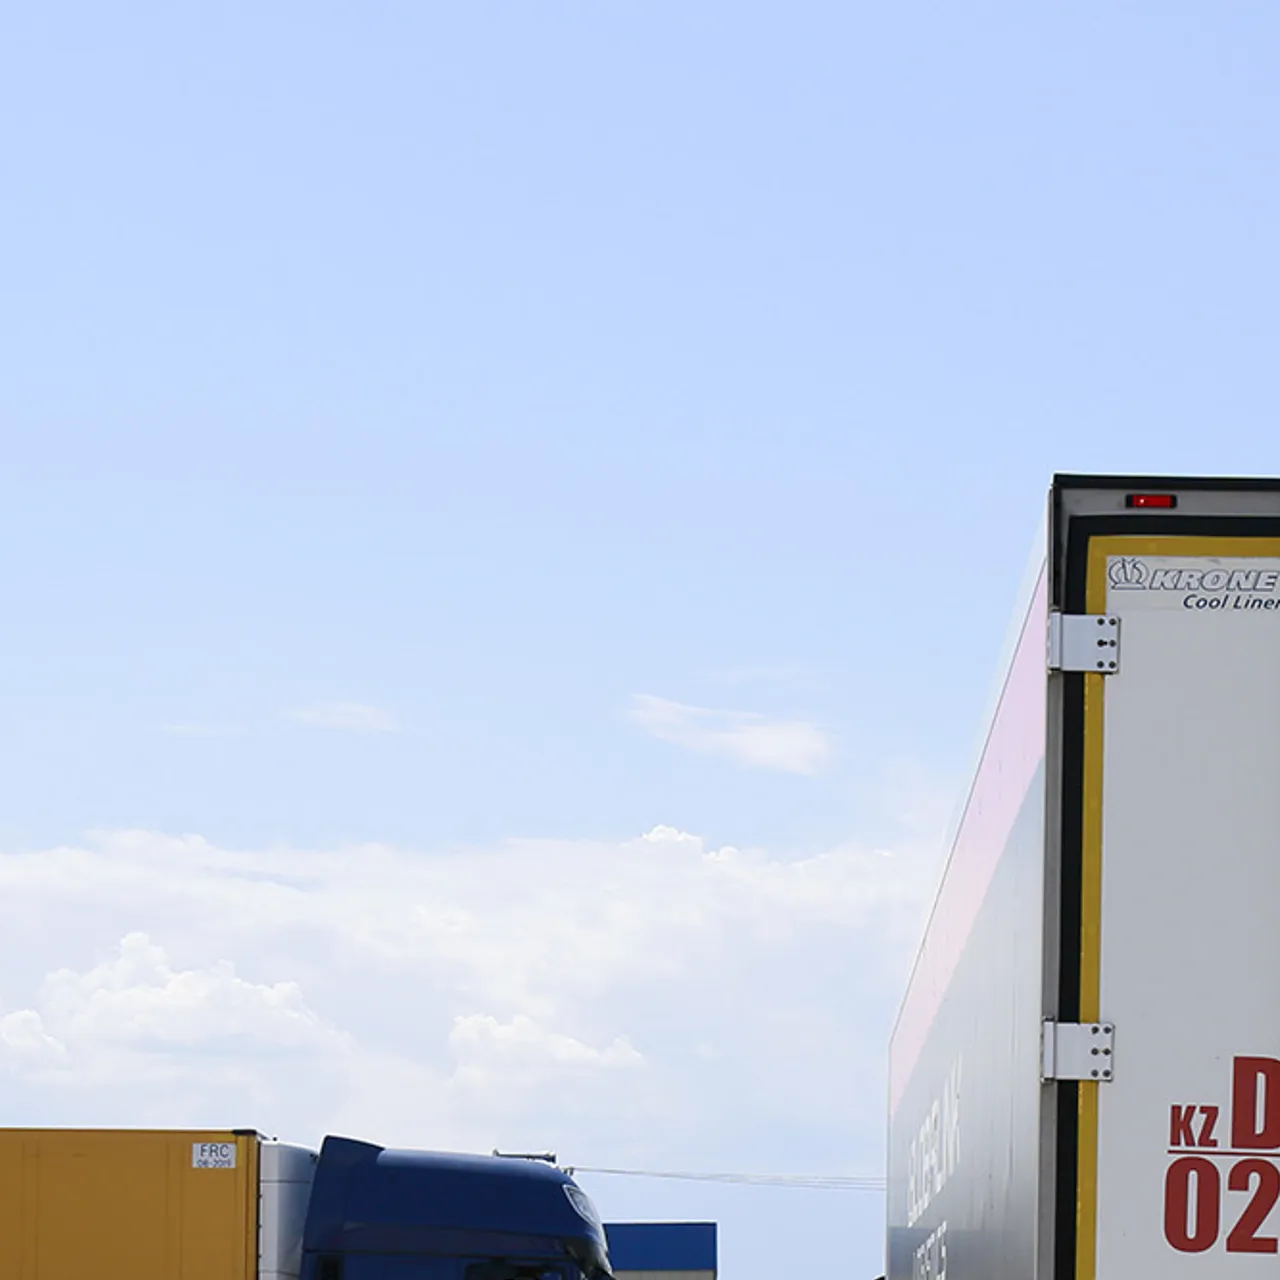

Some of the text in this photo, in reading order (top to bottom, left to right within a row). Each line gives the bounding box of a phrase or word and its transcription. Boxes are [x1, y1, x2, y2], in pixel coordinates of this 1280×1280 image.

[1149, 568, 1280, 592] KRONE
[1183, 594, 1229, 610] Cool
[1170, 1104, 1219, 1148] KZ
[200, 1144, 229, 1158] FRC
